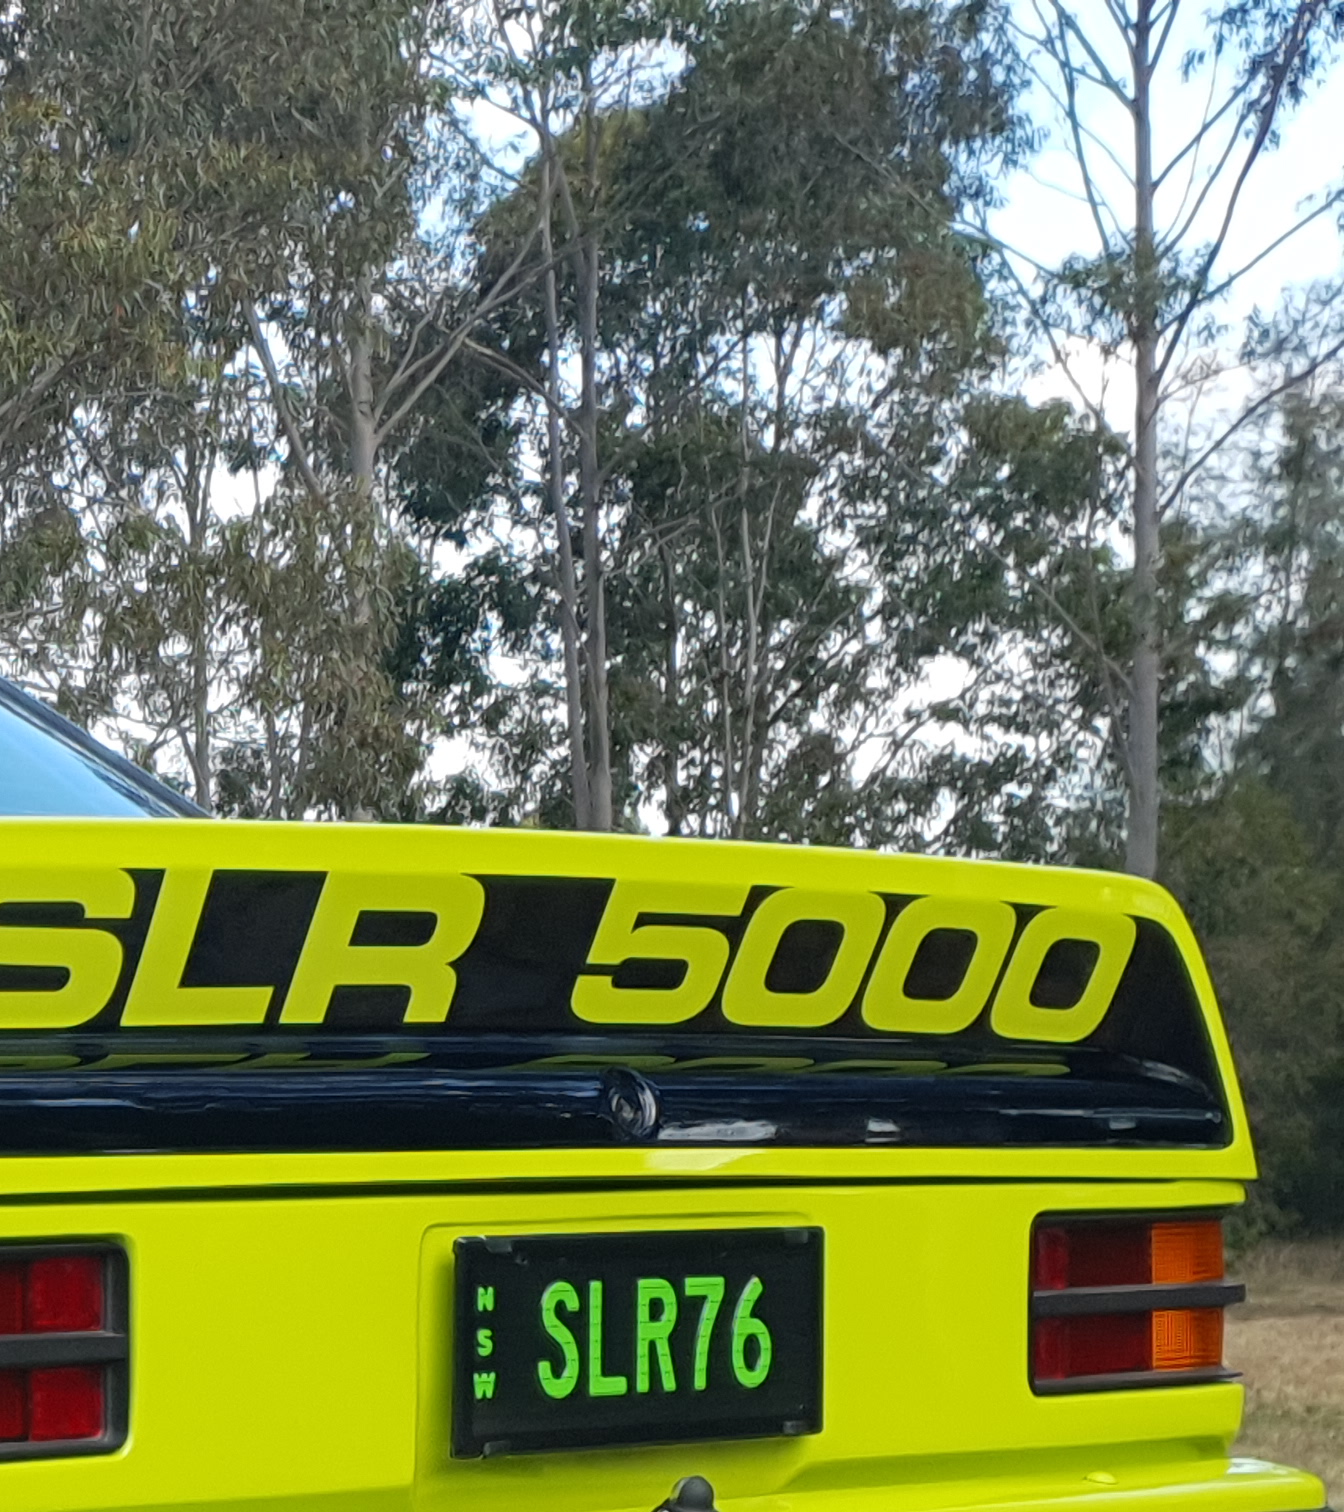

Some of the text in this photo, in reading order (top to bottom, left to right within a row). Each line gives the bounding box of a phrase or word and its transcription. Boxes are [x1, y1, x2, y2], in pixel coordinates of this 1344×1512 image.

[569, 879, 1136, 1042] 5000
[473, 1286, 496, 1400] NSW
[538, 1275, 772, 1399] SLR76
